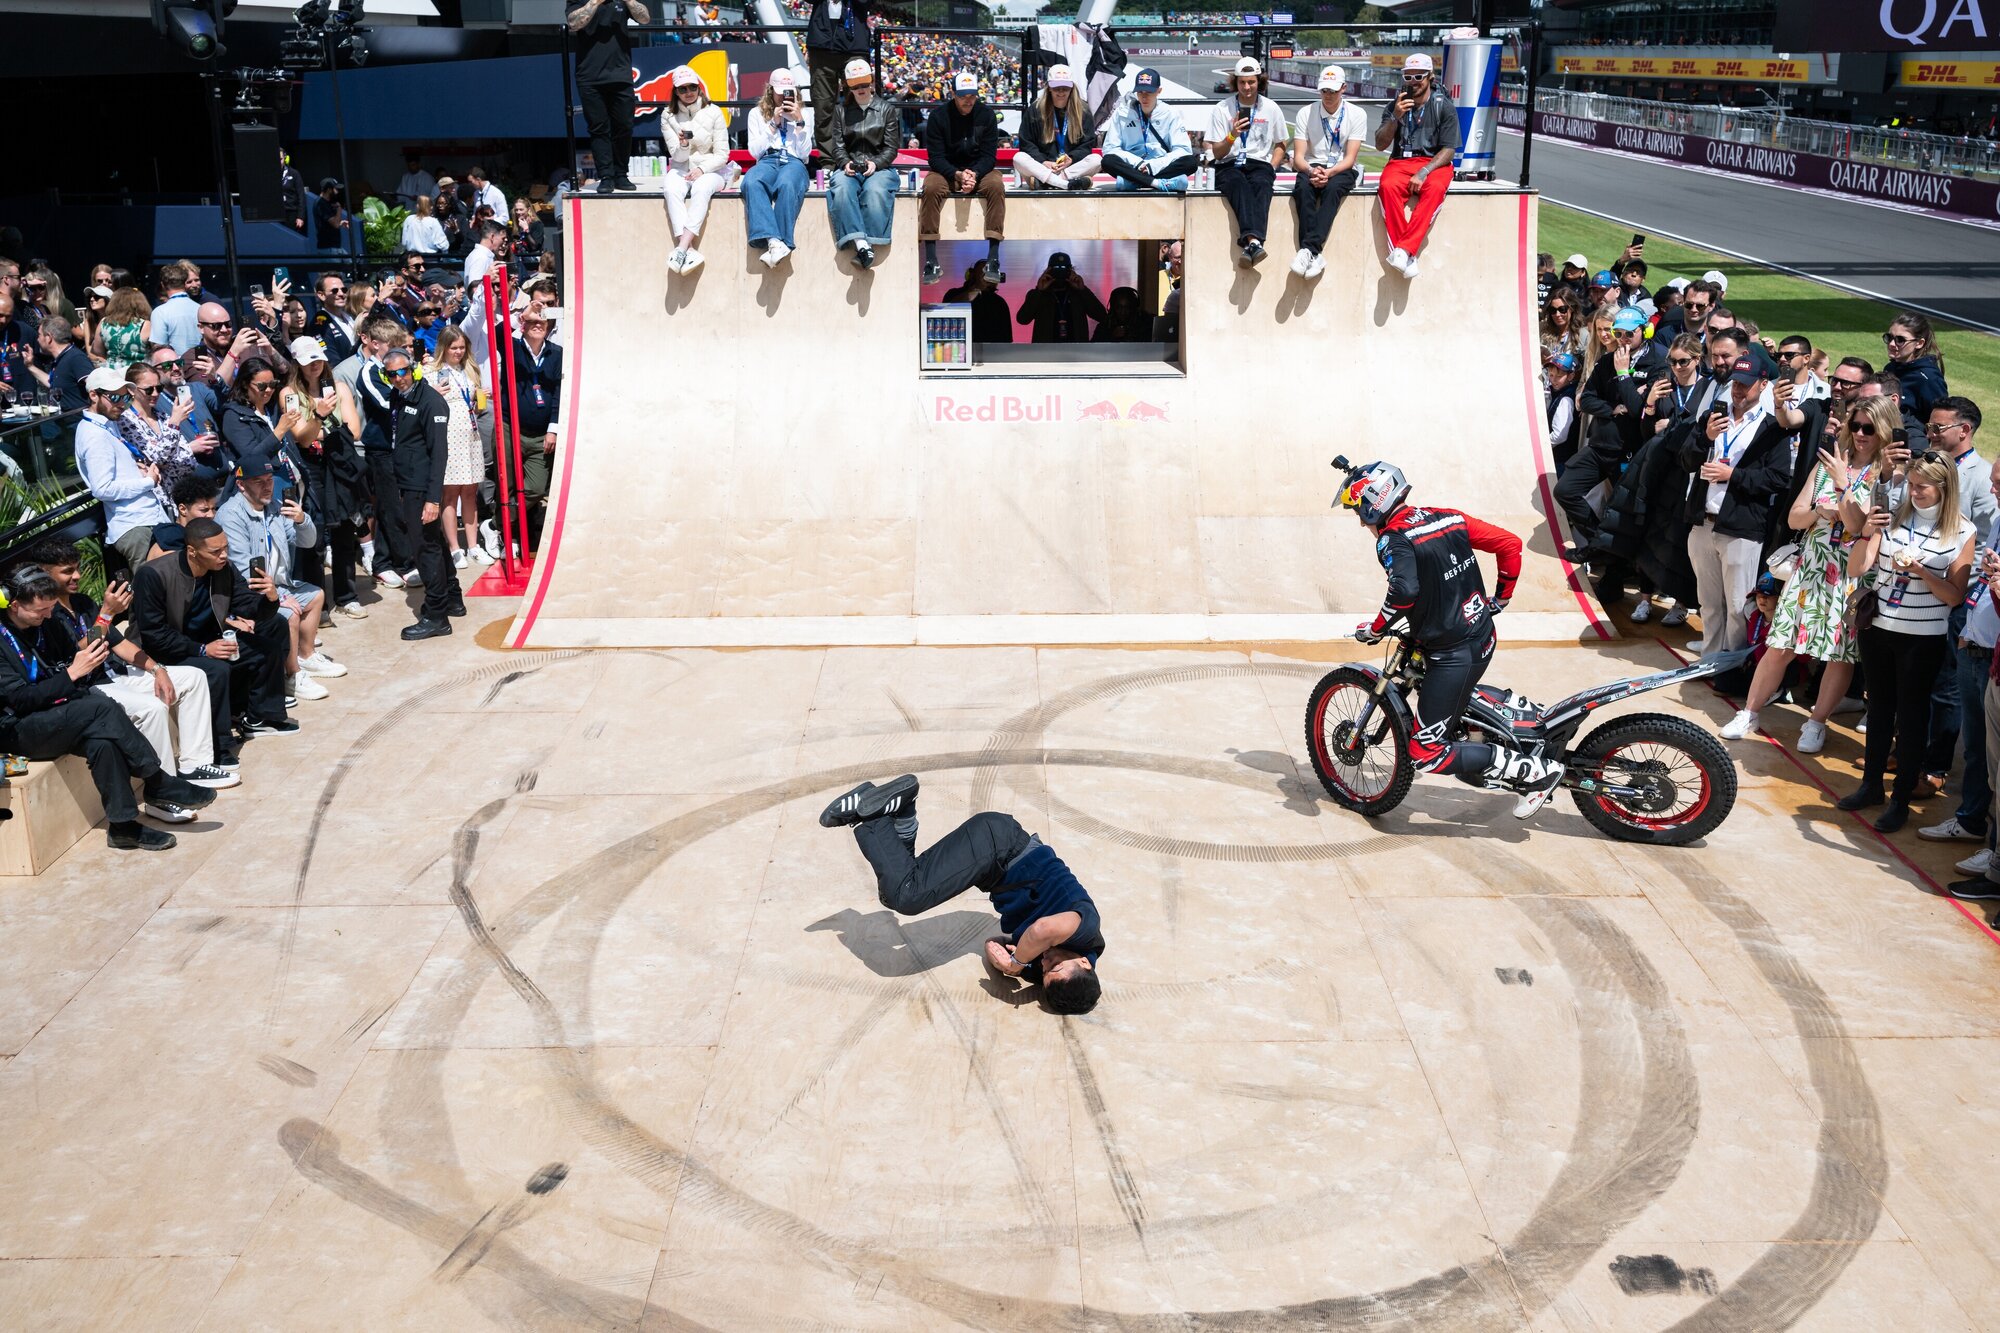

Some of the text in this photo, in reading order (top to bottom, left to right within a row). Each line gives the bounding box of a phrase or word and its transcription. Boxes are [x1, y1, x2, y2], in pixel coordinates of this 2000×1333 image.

[1880, 0, 2000, 45] QA
[1596, 60, 1617, 72] DHL
[1632, 60, 1655, 73] DHL
[1671, 61, 1696, 74] DHL
[1715, 61, 1743, 76] DHL
[1765, 62, 1796, 78] DHL
[1917, 65, 1959, 82] DHL
[1504, 108, 1527, 126] AIRWAY
[1542, 114, 1597, 141] QATAR AIRWAYS
[1614, 126, 1644, 150] QATAR
[1644, 131, 1685, 157] AIRWAYS
[1706, 141, 1743, 168] QATAR
[1744, 147, 1797, 177] AIRWAYS
[1829, 160, 1879, 193] QATAR
[1881, 169, 1952, 206] AIRWAYS
[935, 394, 1061, 422] Red Bull
[1372, 482, 1392, 511] Red Bull
